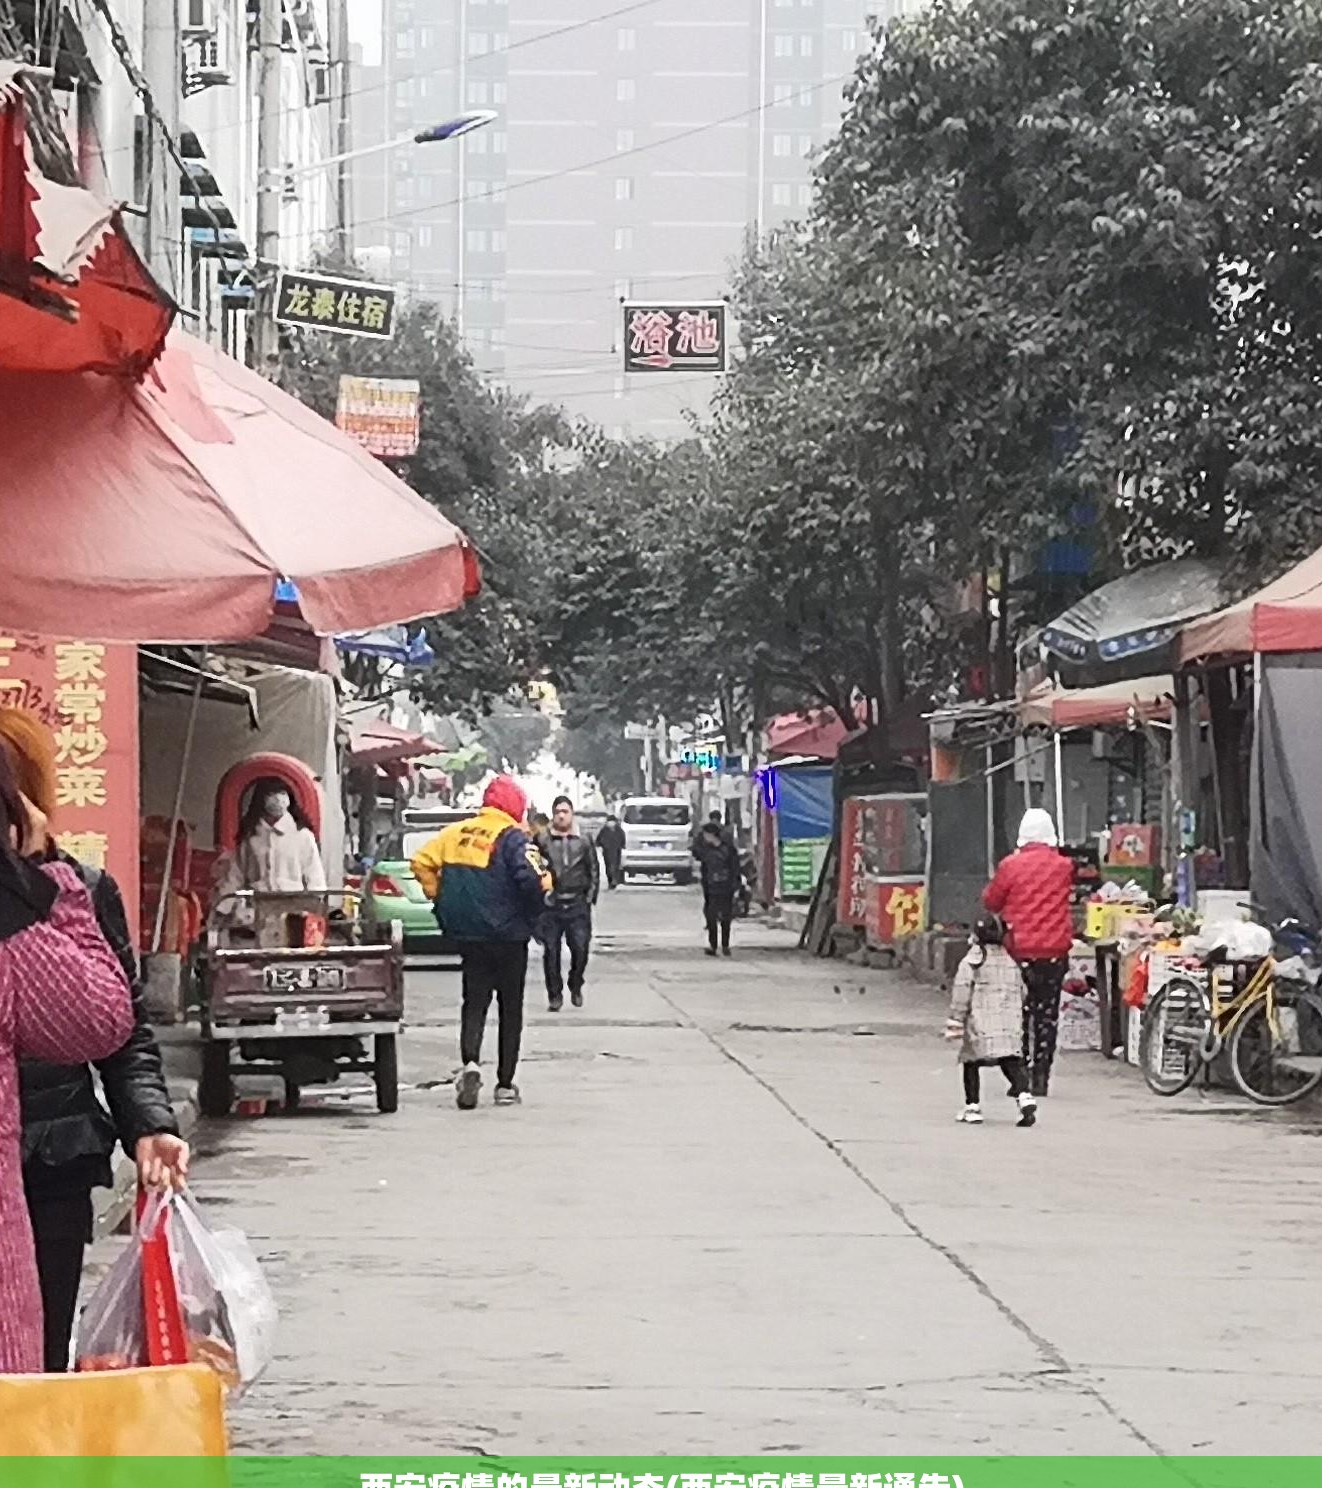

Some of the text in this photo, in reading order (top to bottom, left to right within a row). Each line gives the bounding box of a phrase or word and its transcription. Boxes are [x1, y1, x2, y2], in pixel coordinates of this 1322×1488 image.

[283, 282, 389, 330] 龙泰住宿
[629, 309, 720, 354] 浴池
[53, 640, 108, 808] 家常炒菜
